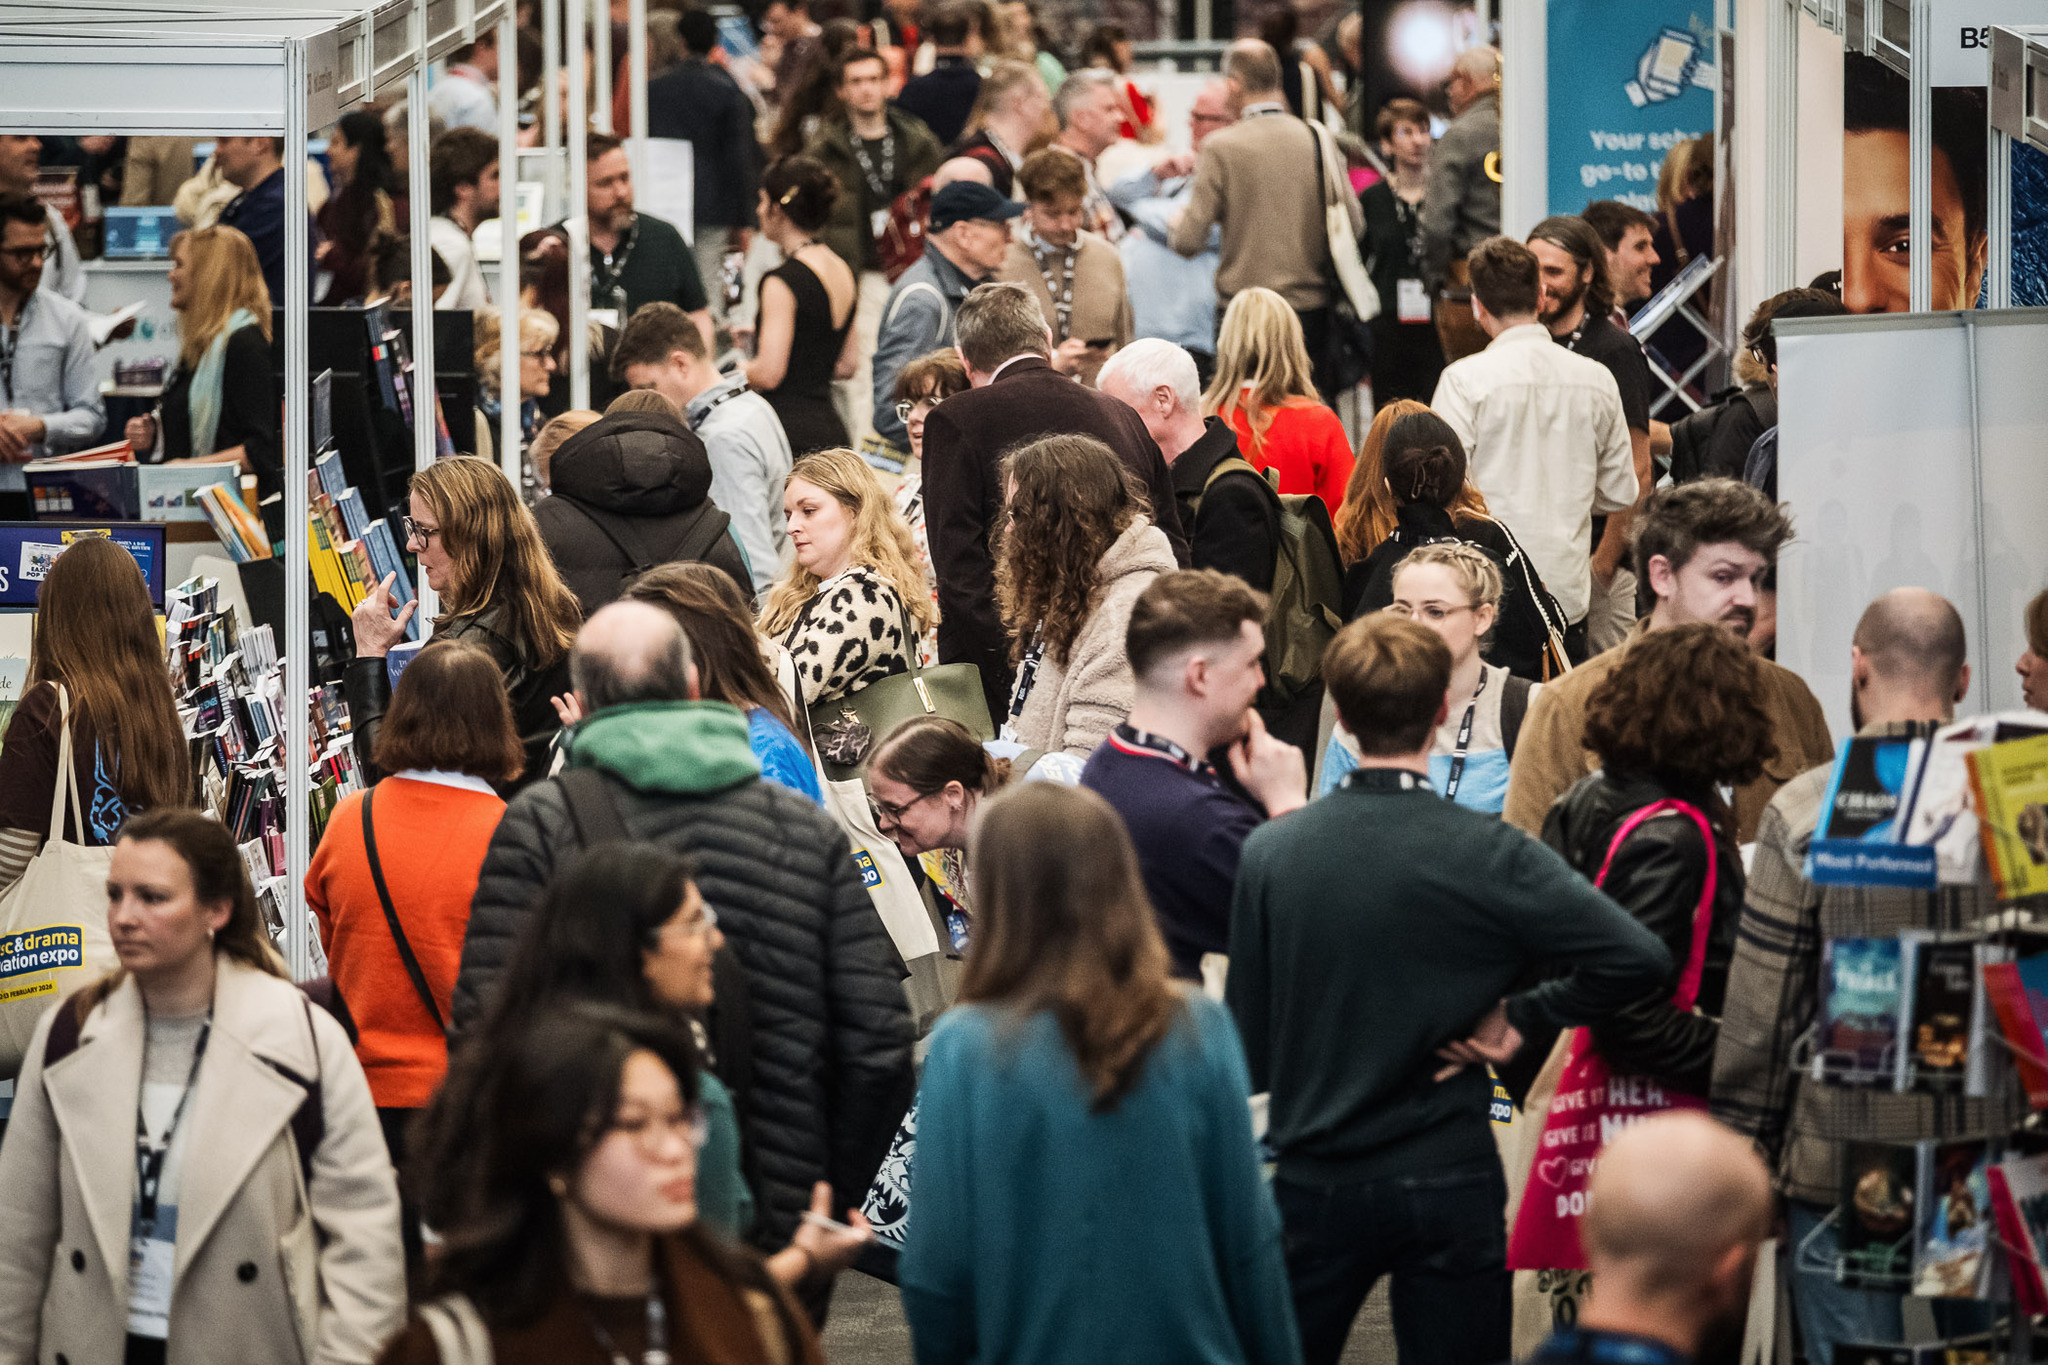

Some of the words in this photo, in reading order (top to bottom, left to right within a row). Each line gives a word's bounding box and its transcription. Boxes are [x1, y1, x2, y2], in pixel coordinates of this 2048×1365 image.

[1589, 130, 1646, 152] Your
[1580, 161, 1648, 188] go-to
[39, 948, 79, 966] expo
[10, 986, 37, 997] FEBRUARY
[39, 984, 52, 992] 2026
[1551, 1089, 1586, 1114] GIVE
[1590, 1086, 1605, 1105] IT
[1543, 1124, 1579, 1148] GIVE
[1581, 1122, 1597, 1142] IT
